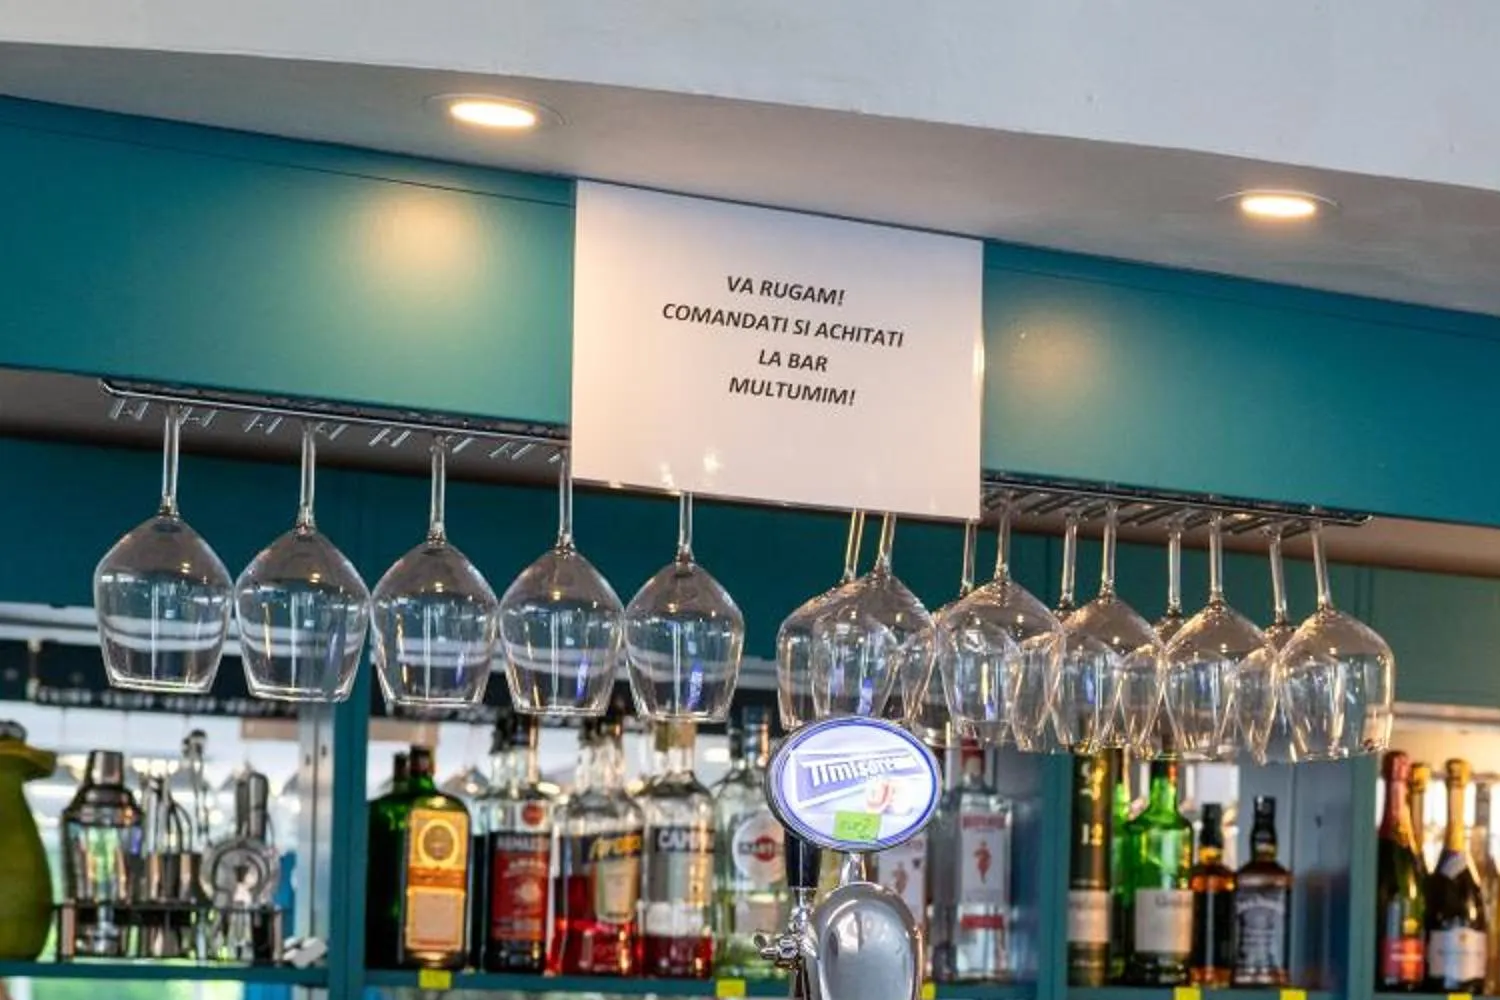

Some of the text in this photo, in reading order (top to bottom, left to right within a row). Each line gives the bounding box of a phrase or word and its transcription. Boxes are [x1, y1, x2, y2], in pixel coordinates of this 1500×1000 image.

[727, 275, 846, 307] VA RUGAM!
[661, 303, 905, 349] COMANDATI SI ACHITATI
[757, 348, 829, 373] LA BAR
[728, 376, 856, 407] MULTUMIM!
